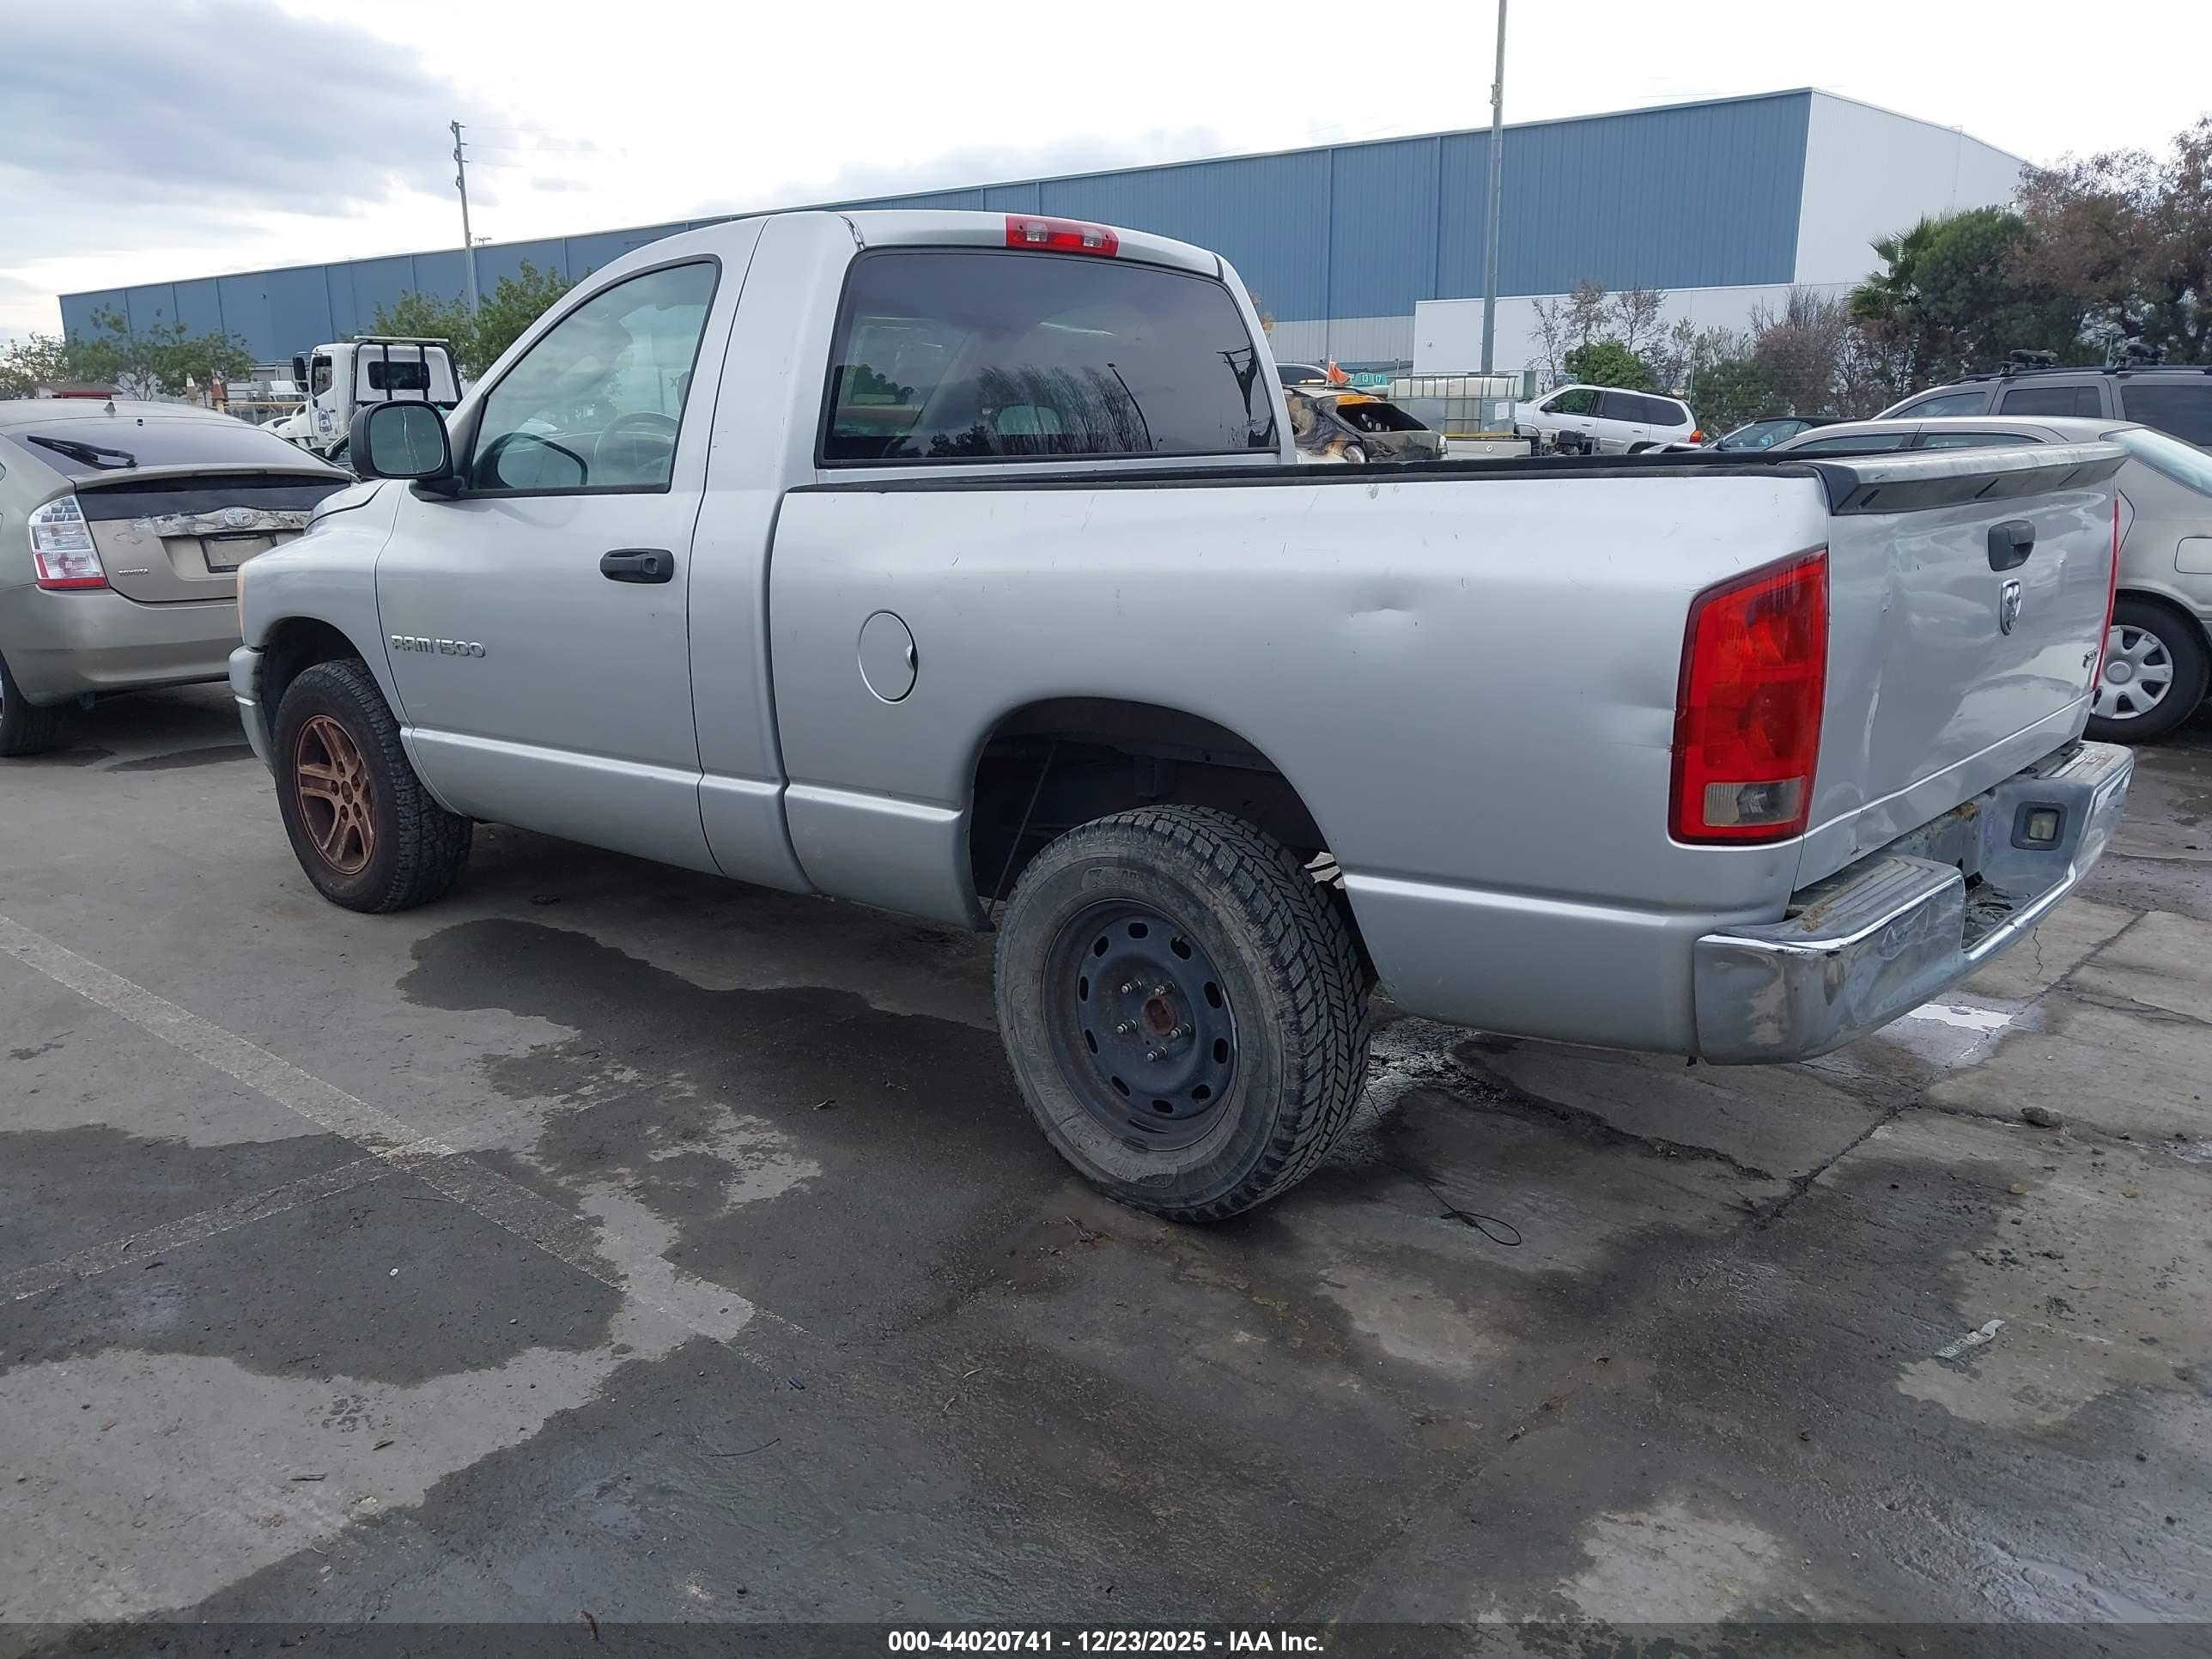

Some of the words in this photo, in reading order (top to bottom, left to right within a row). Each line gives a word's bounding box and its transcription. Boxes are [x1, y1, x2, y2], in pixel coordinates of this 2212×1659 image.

[1362, 374, 1369, 383] 13
[391, 635, 434, 653] RAM
[434, 638, 486, 659] 1500
